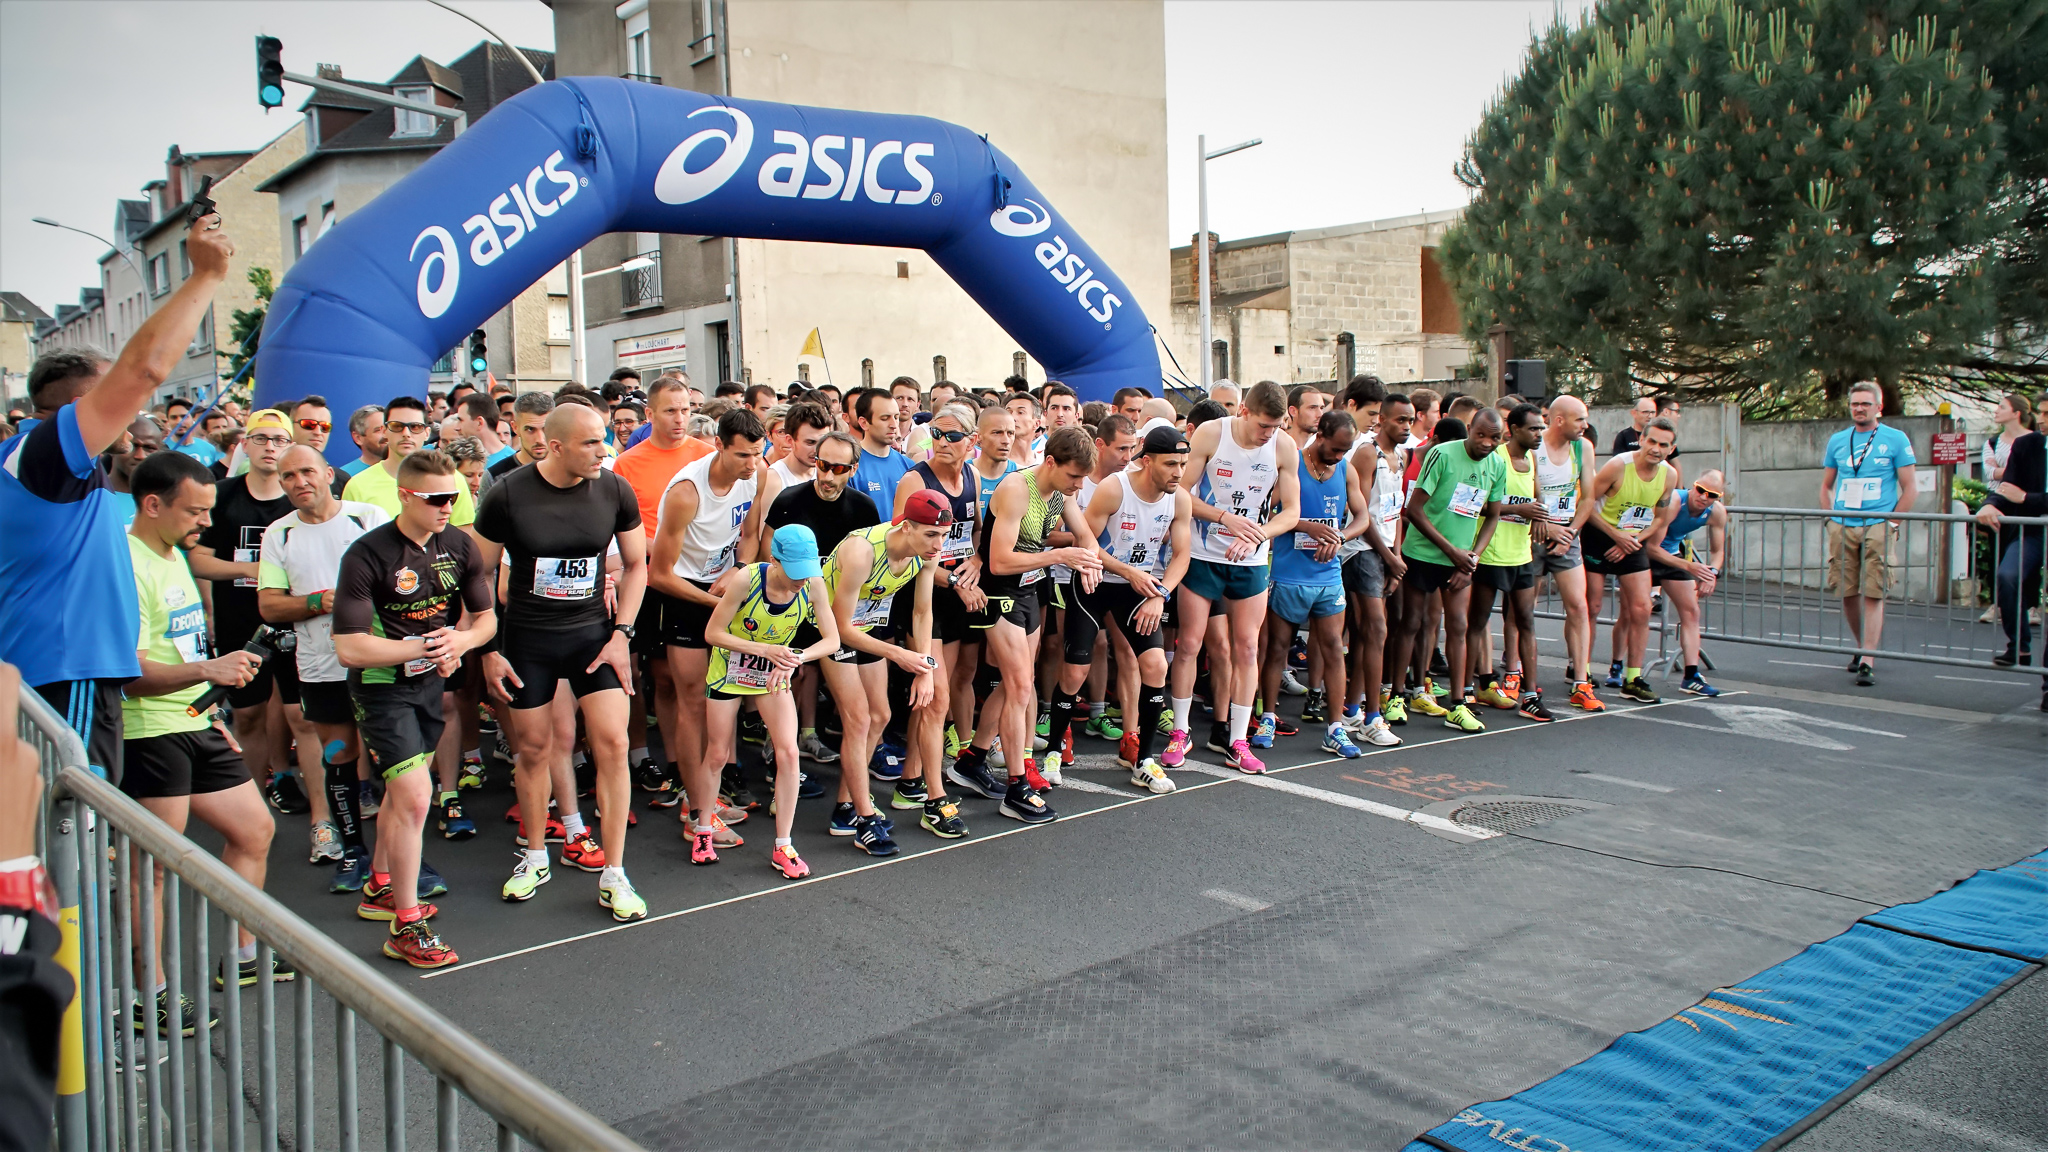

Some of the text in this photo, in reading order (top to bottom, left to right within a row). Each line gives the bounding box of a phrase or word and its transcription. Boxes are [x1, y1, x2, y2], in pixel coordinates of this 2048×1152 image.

[1558, 498, 1569, 510] 50
[1633, 507, 1646, 518] 81
[1129, 551, 1146, 564] 56
[555, 559, 588, 579] 453
